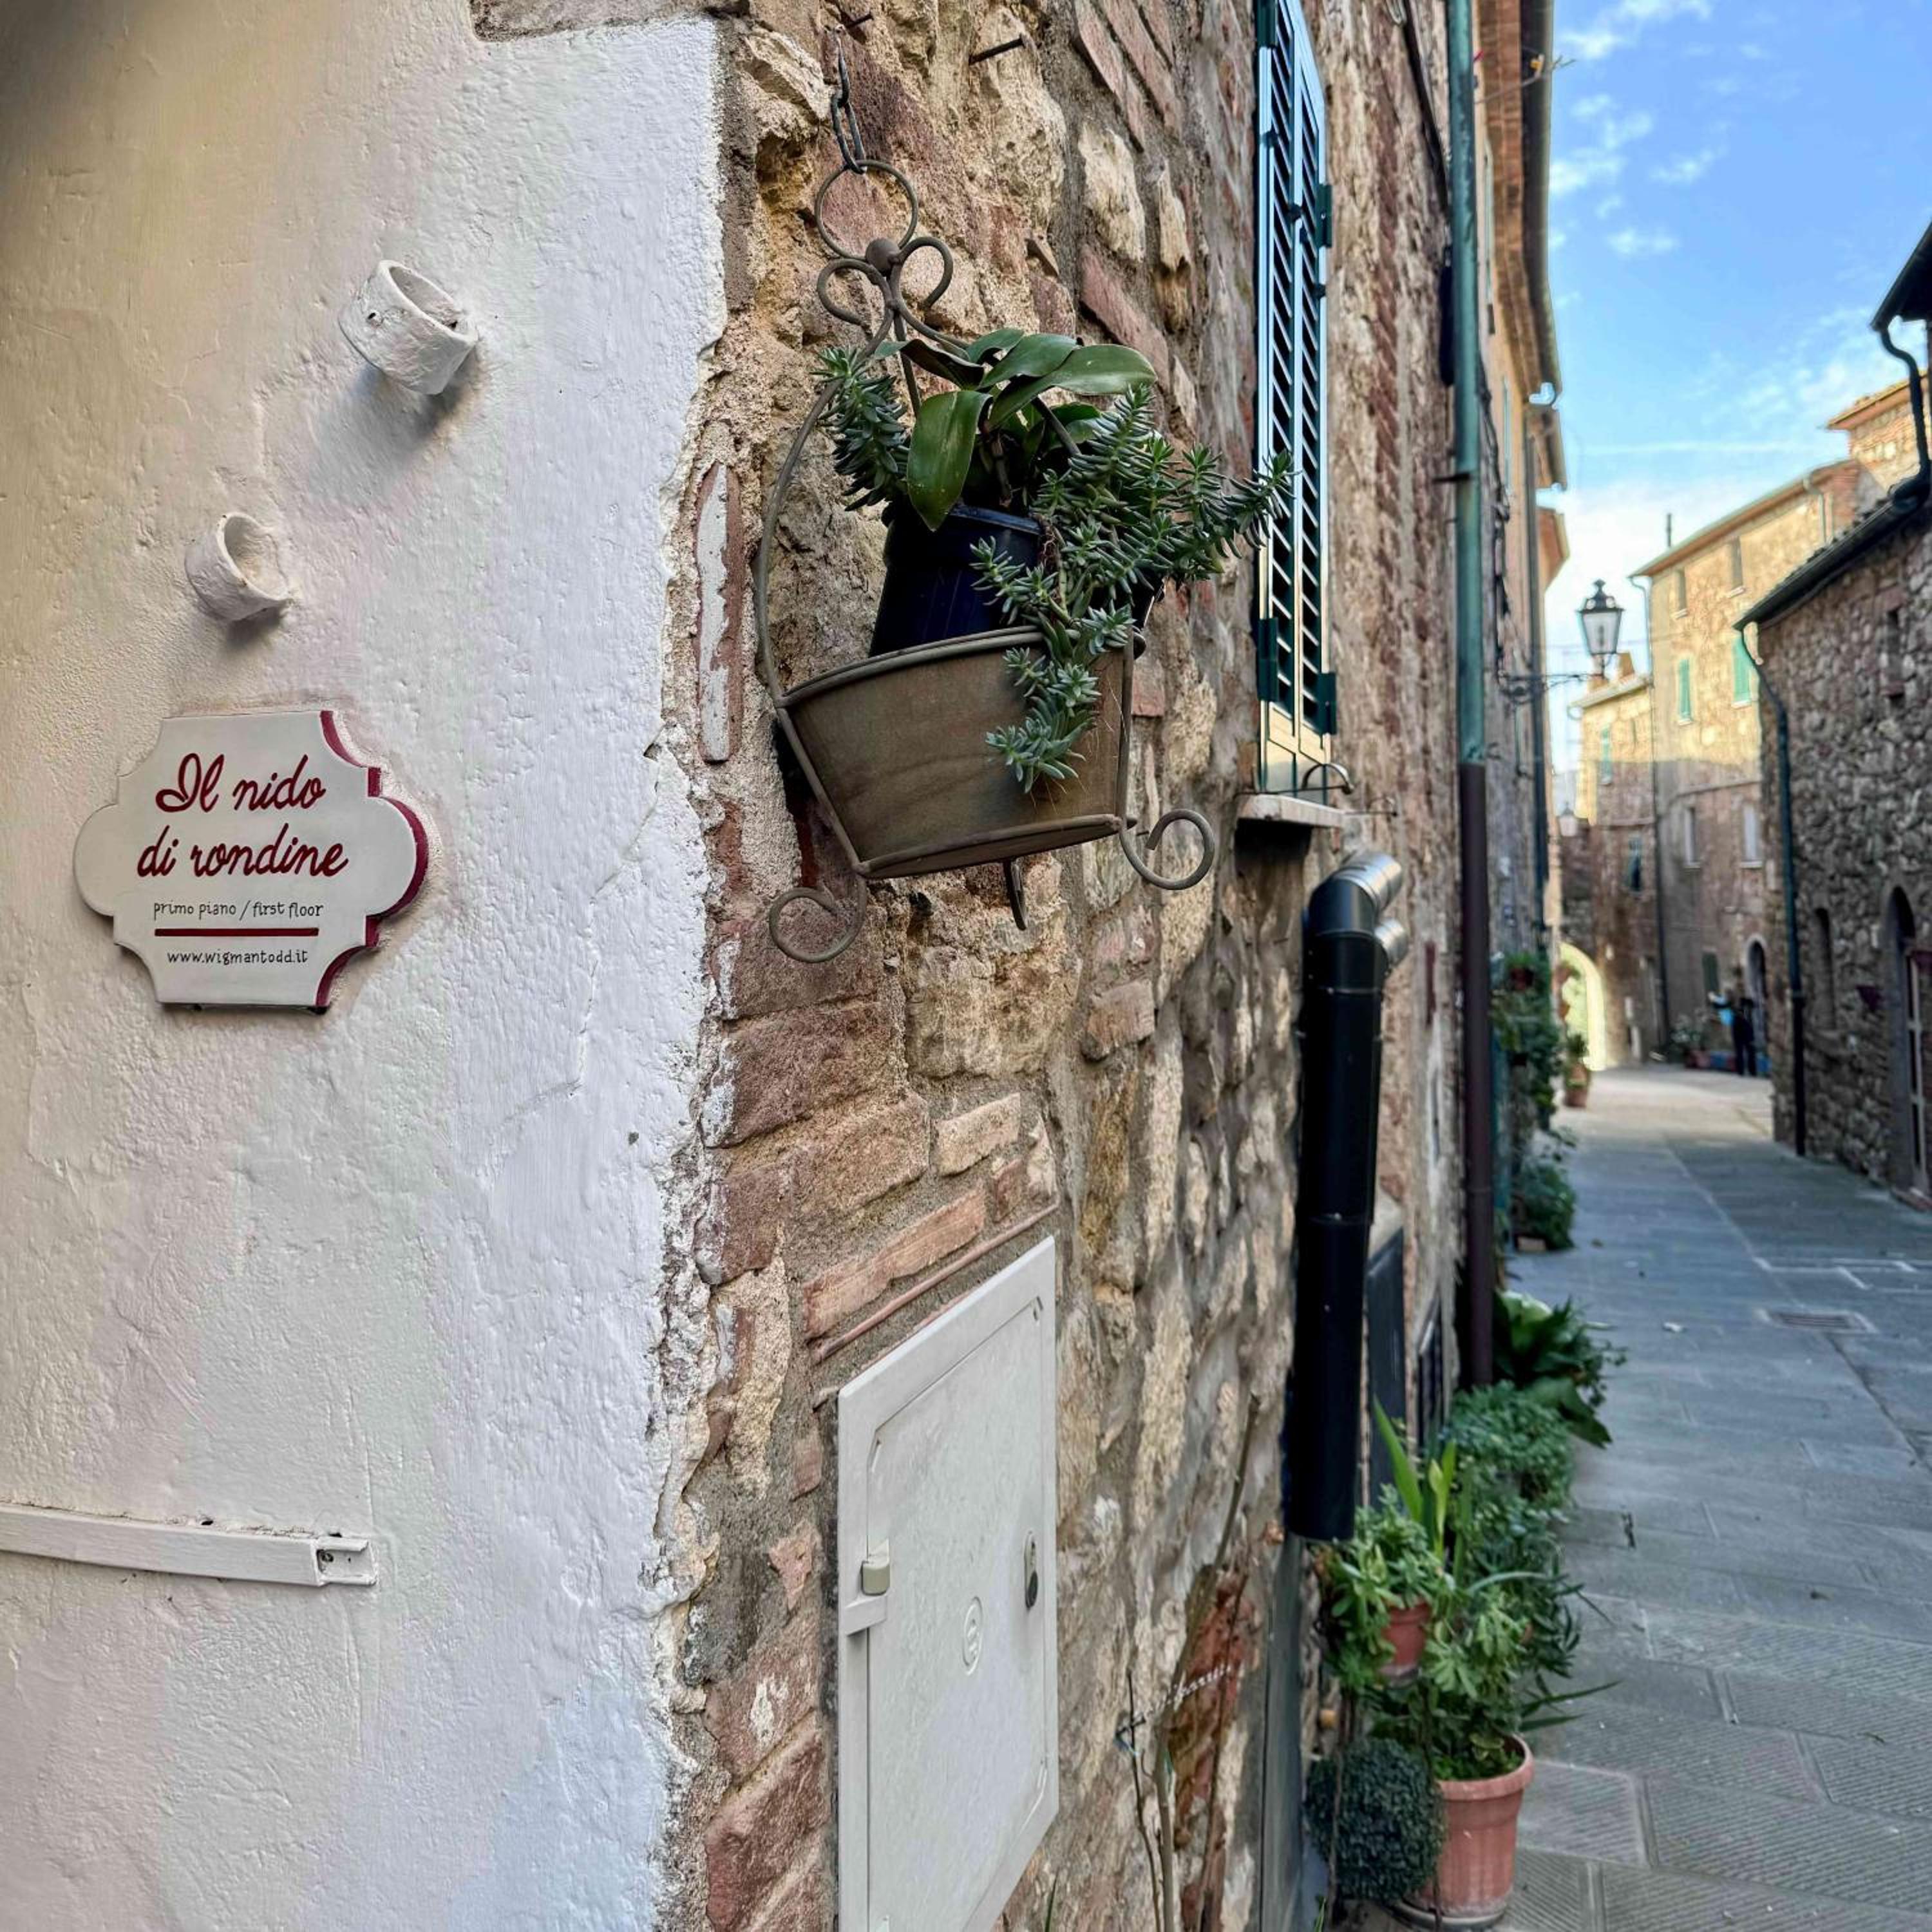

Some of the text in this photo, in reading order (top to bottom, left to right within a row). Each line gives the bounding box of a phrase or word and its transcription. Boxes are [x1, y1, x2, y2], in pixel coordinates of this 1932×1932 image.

[155, 752, 327, 813] Il nido
[137, 822, 349, 877] di rondine
[153, 900, 194, 922] primo
[198, 900, 236, 921] piano
[252, 900, 285, 918] first
[288, 902, 325, 920] floor
[167, 948, 308, 966] www.wigmantodd.it
